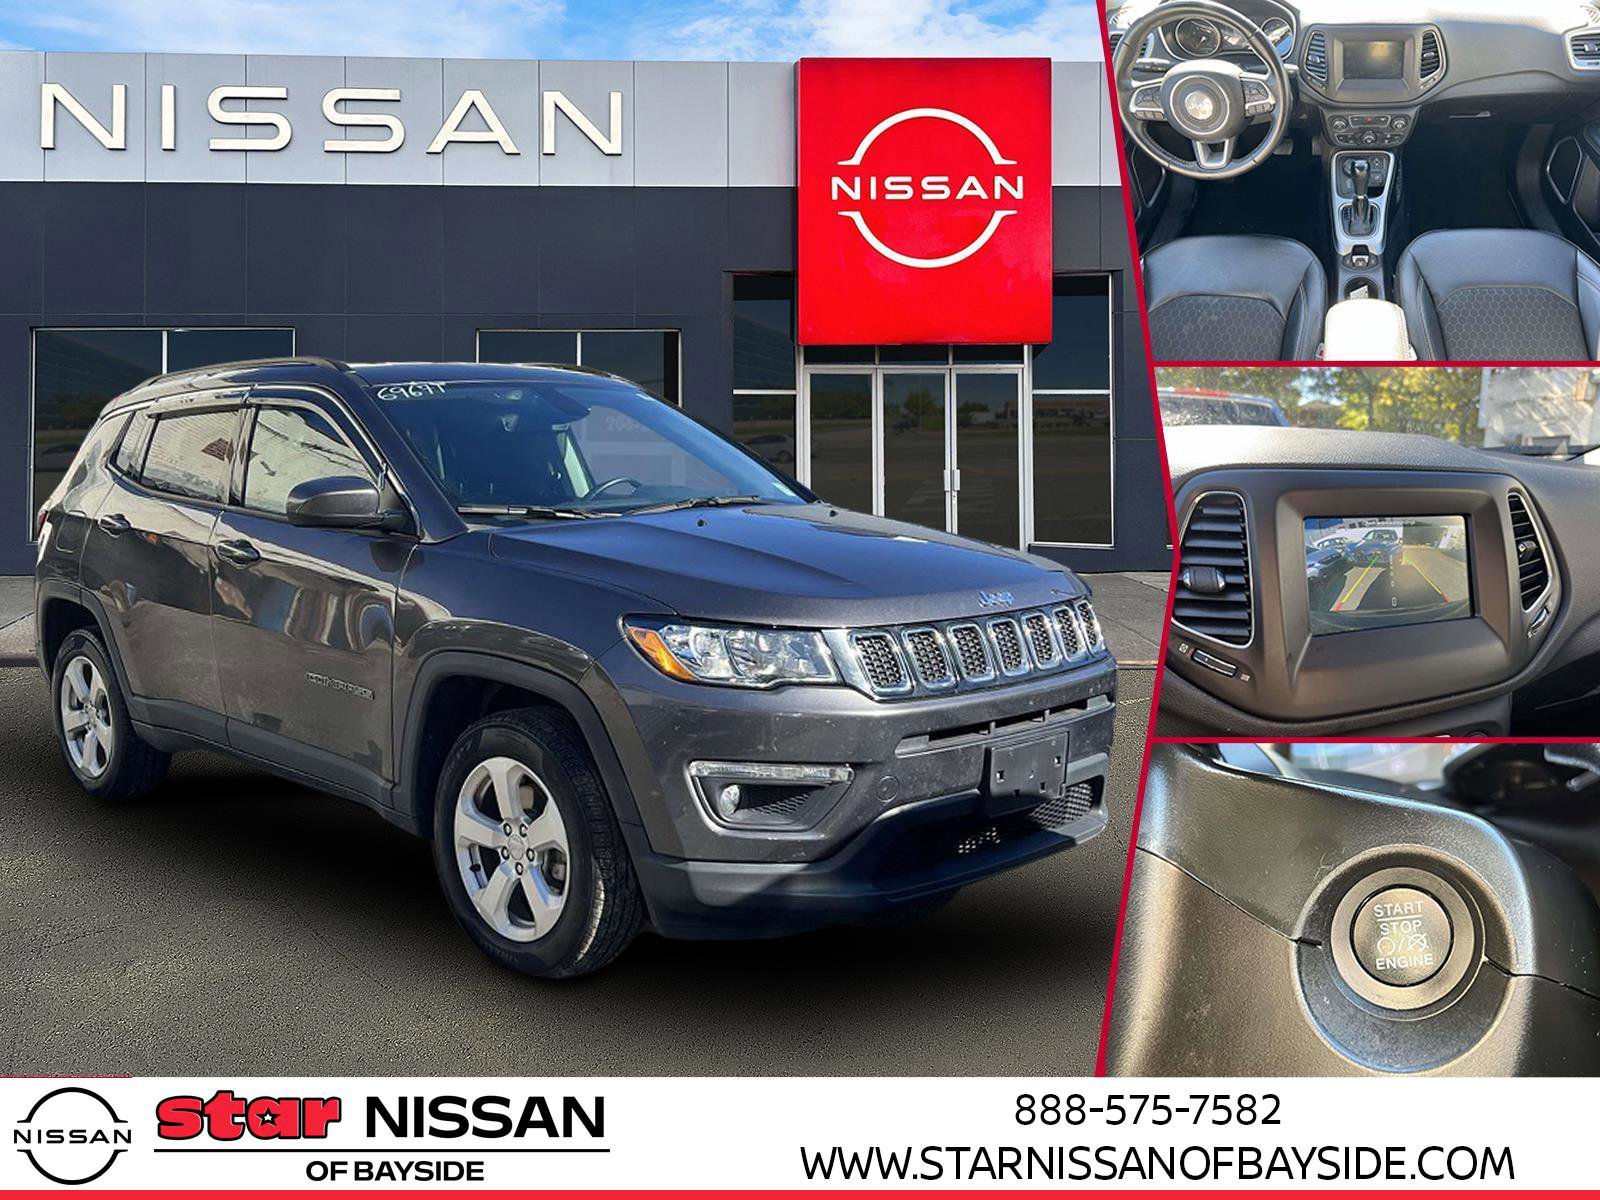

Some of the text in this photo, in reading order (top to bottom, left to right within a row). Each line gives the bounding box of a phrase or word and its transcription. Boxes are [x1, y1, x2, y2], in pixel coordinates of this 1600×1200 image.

[41, 83, 622, 155] NISSAN
[831, 175, 1024, 200] NISSAN
[1373, 901, 1424, 917] START
[1380, 920, 1422, 935] STOP
[1375, 953, 1434, 970] ENGINE
